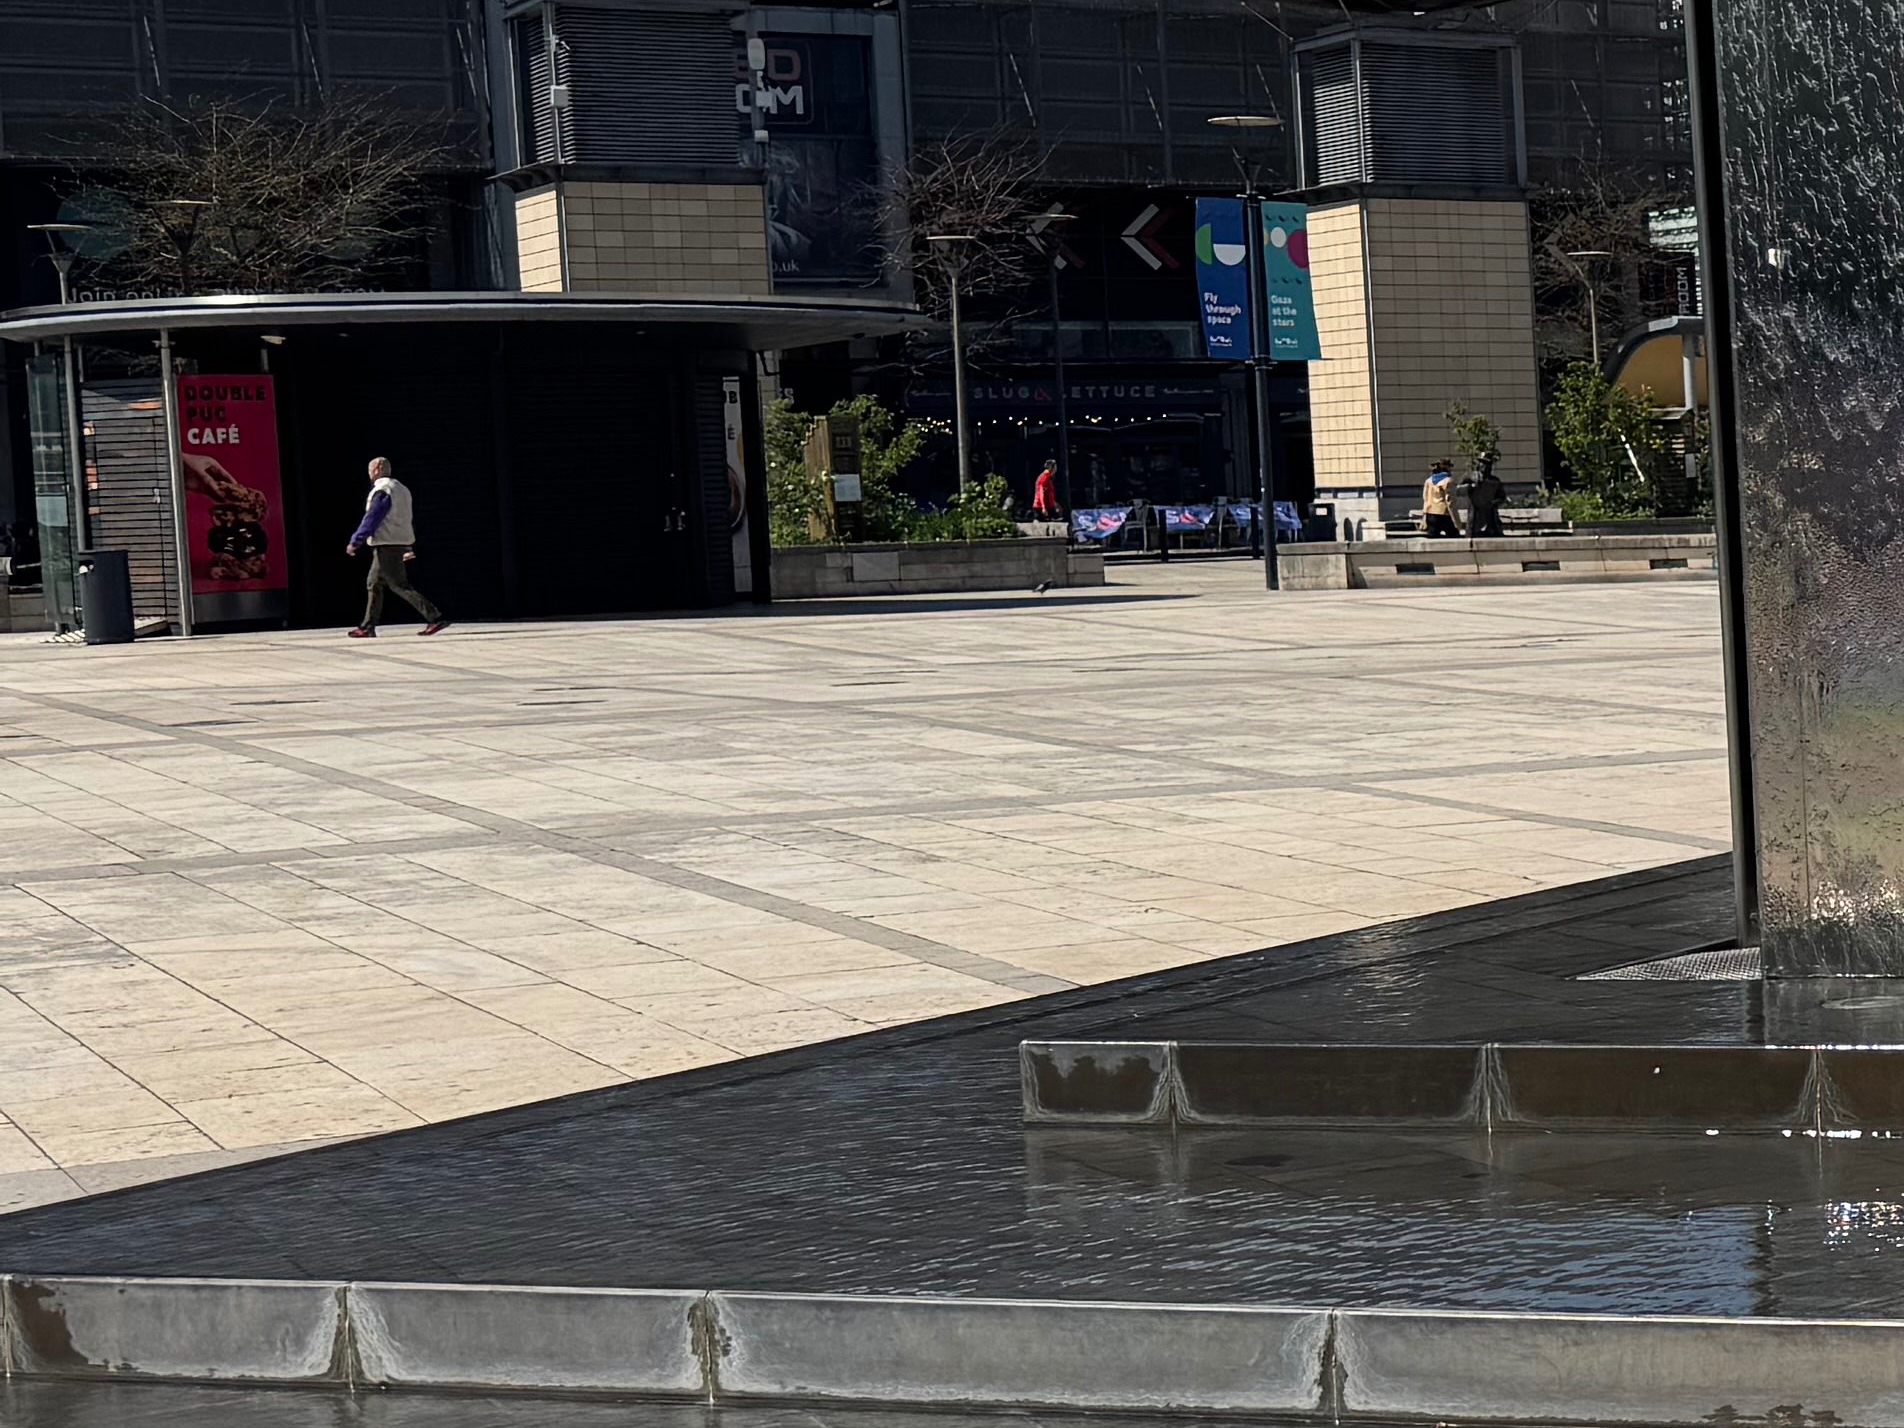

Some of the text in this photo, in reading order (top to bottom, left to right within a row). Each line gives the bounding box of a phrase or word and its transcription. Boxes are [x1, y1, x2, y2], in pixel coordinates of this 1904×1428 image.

[1204, 292, 1218, 304] Fly
[1206, 305, 1242, 317] through
[1282, 306, 1298, 316] the
[1208, 316, 1232, 326] space
[1273, 318, 1295, 327] stars
[185, 385, 266, 402] DOUBLE
[973, 386, 1031, 400] SLUG
[187, 424, 240, 445] CAFÉ
